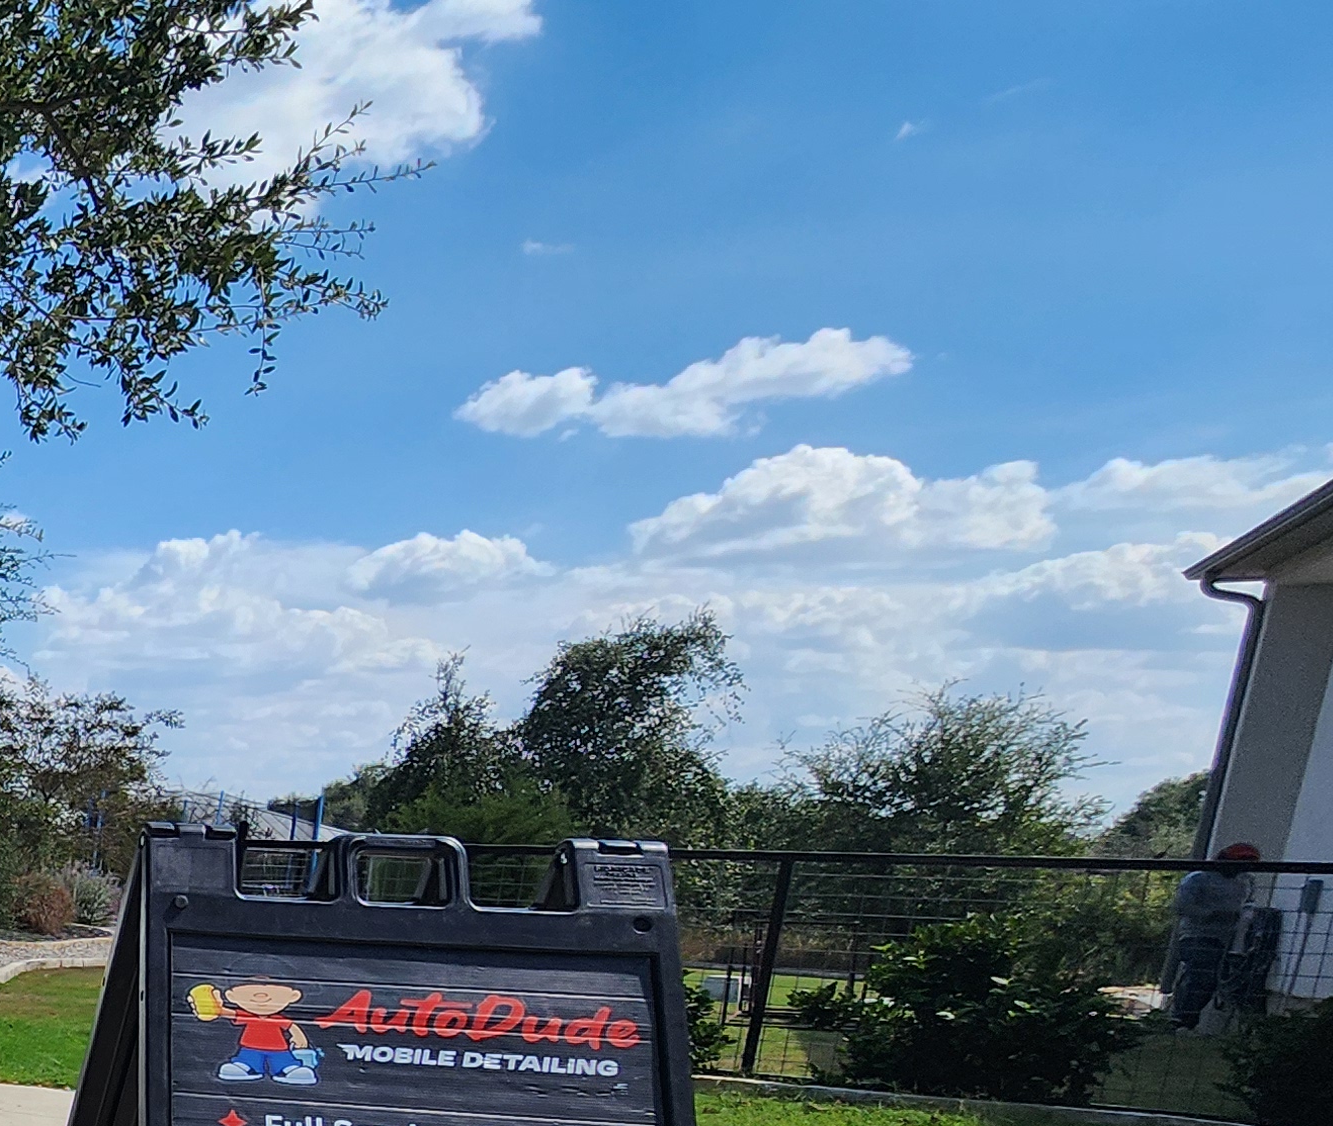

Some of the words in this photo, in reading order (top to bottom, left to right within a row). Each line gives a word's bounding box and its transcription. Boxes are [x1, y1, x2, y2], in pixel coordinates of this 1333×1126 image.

[314, 989, 641, 1050] AutoDude
[336, 1043, 456, 1067] MOBILE
[461, 1051, 620, 1077] DETAILING
